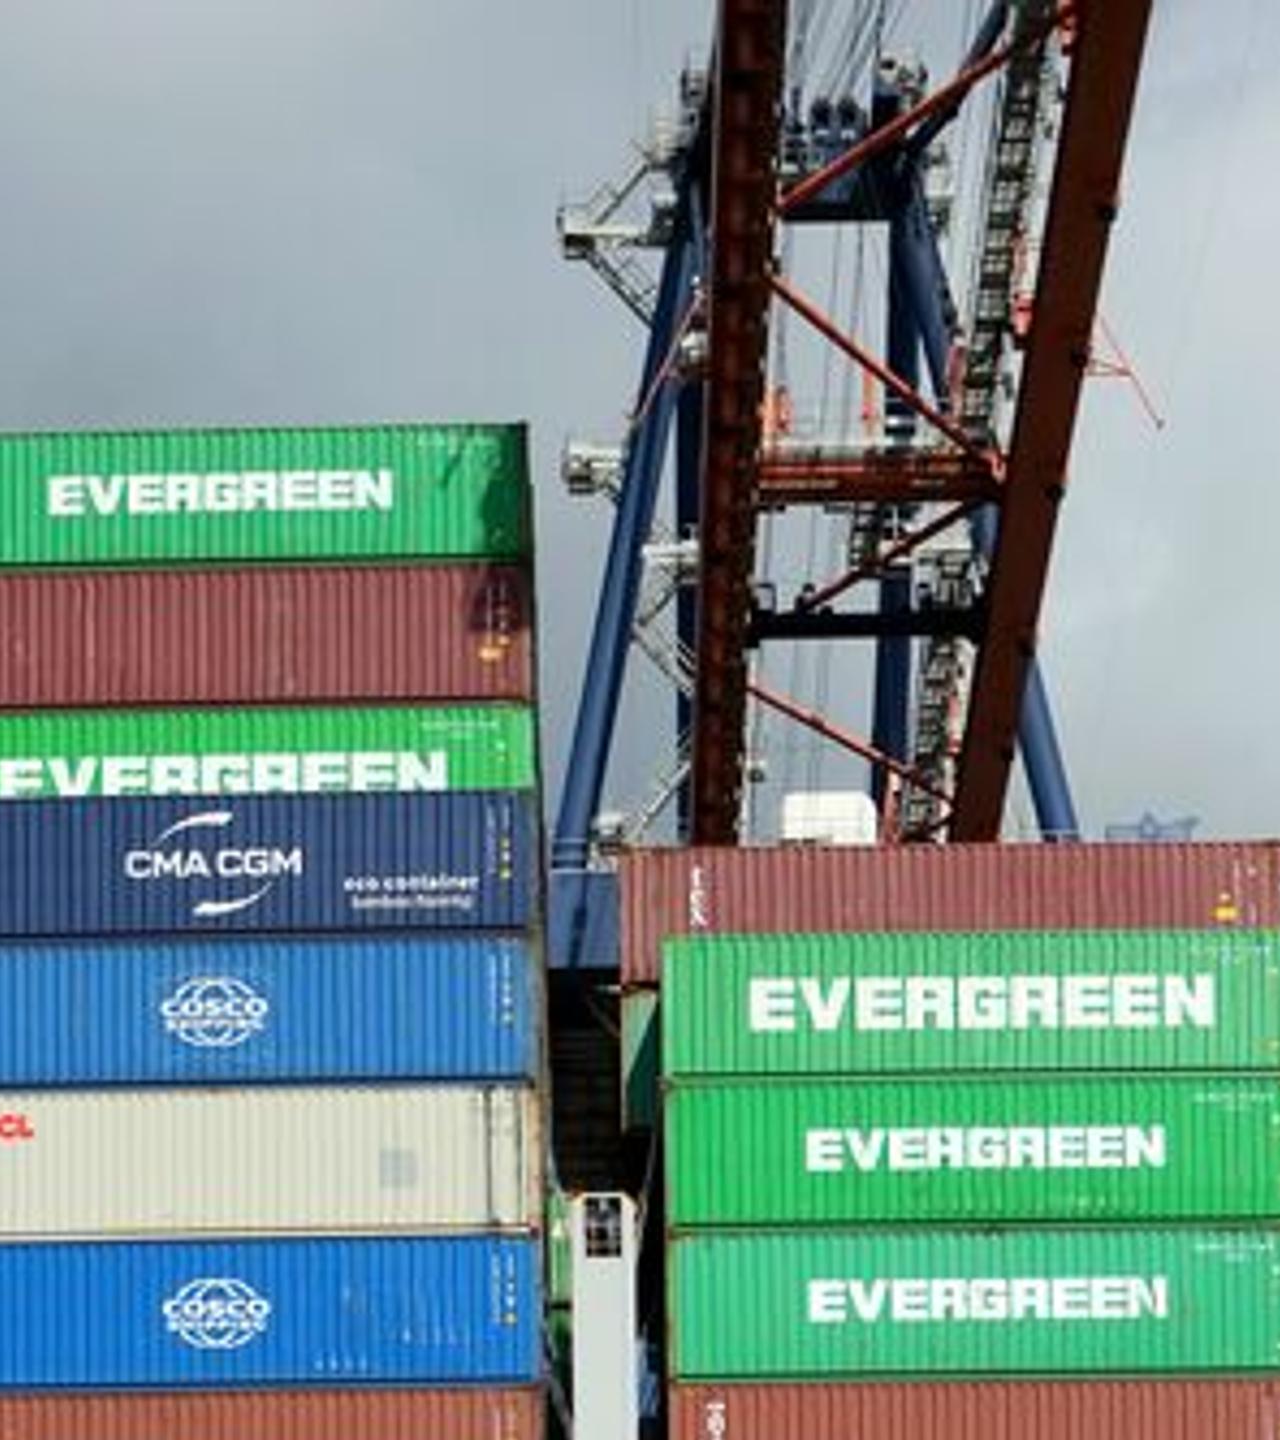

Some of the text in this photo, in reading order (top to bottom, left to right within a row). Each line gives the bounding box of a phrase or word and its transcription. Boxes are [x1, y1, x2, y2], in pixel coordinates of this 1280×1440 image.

[49, 470, 392, 515] EVERGREEN
[0, 751, 447, 797] EVERGREEN
[127, 849, 302, 878] CMA CGM
[161, 998, 268, 1017] COSCO
[749, 974, 1215, 1031] EVERGREEN
[806, 1126, 1164, 1170] EVERGREEN
[163, 1299, 271, 1318] COSCO
[809, 1277, 1167, 1322] EVERGREEN
